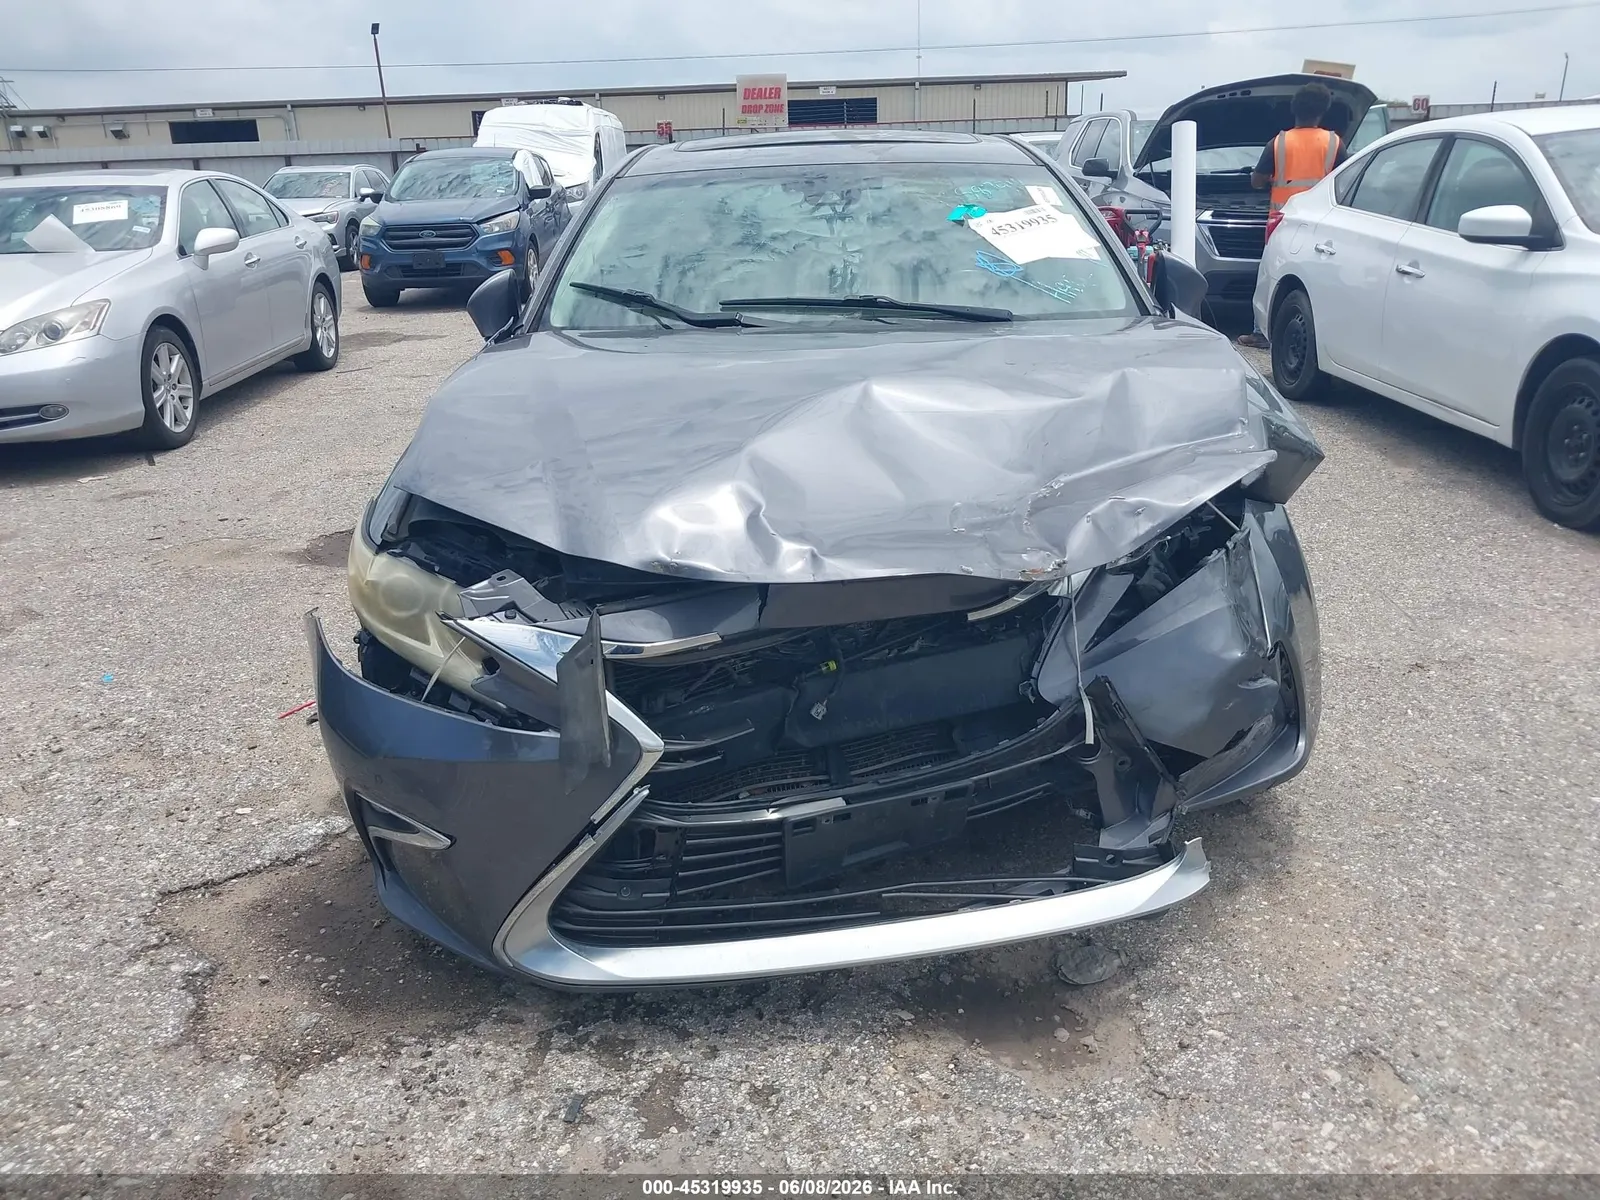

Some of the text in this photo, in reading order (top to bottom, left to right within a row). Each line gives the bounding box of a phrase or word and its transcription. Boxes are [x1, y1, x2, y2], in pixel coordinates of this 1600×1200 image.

[743, 87, 782, 100] DEALER
[741, 103, 785, 114] DROP ZONE
[1412, 97, 1429, 111] 60
[991, 214, 1058, 236] 45319935
